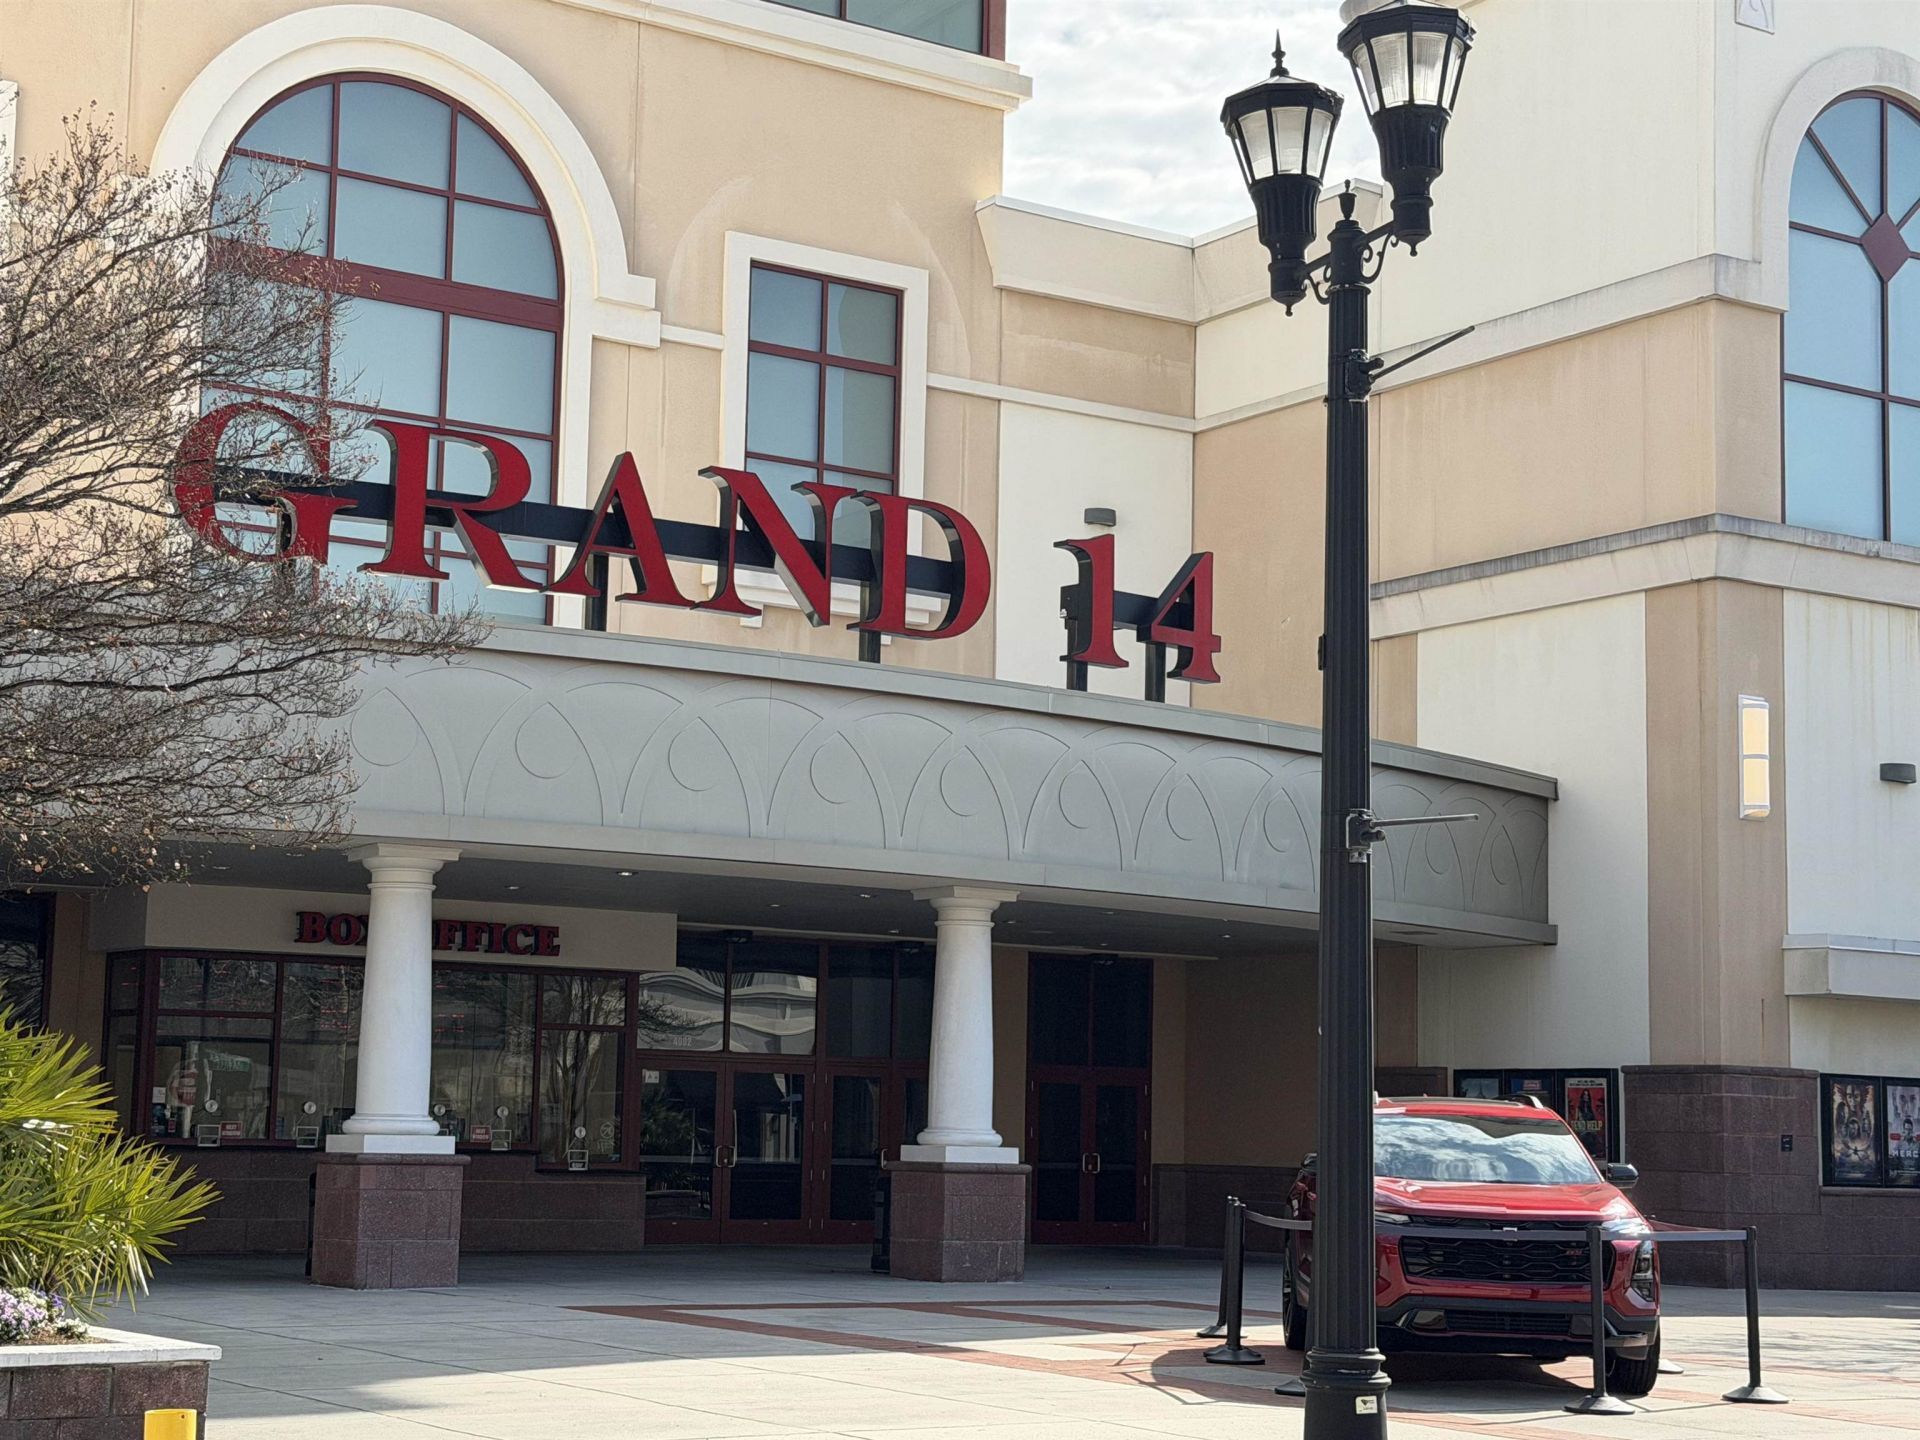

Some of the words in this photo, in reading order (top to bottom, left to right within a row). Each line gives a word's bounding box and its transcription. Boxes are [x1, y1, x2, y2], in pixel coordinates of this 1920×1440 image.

[174, 401, 991, 638] GRAND
[1054, 534, 1222, 684] 14
[432, 920, 560, 956] FFICE
[1587, 1120, 1603, 1131] HELP
